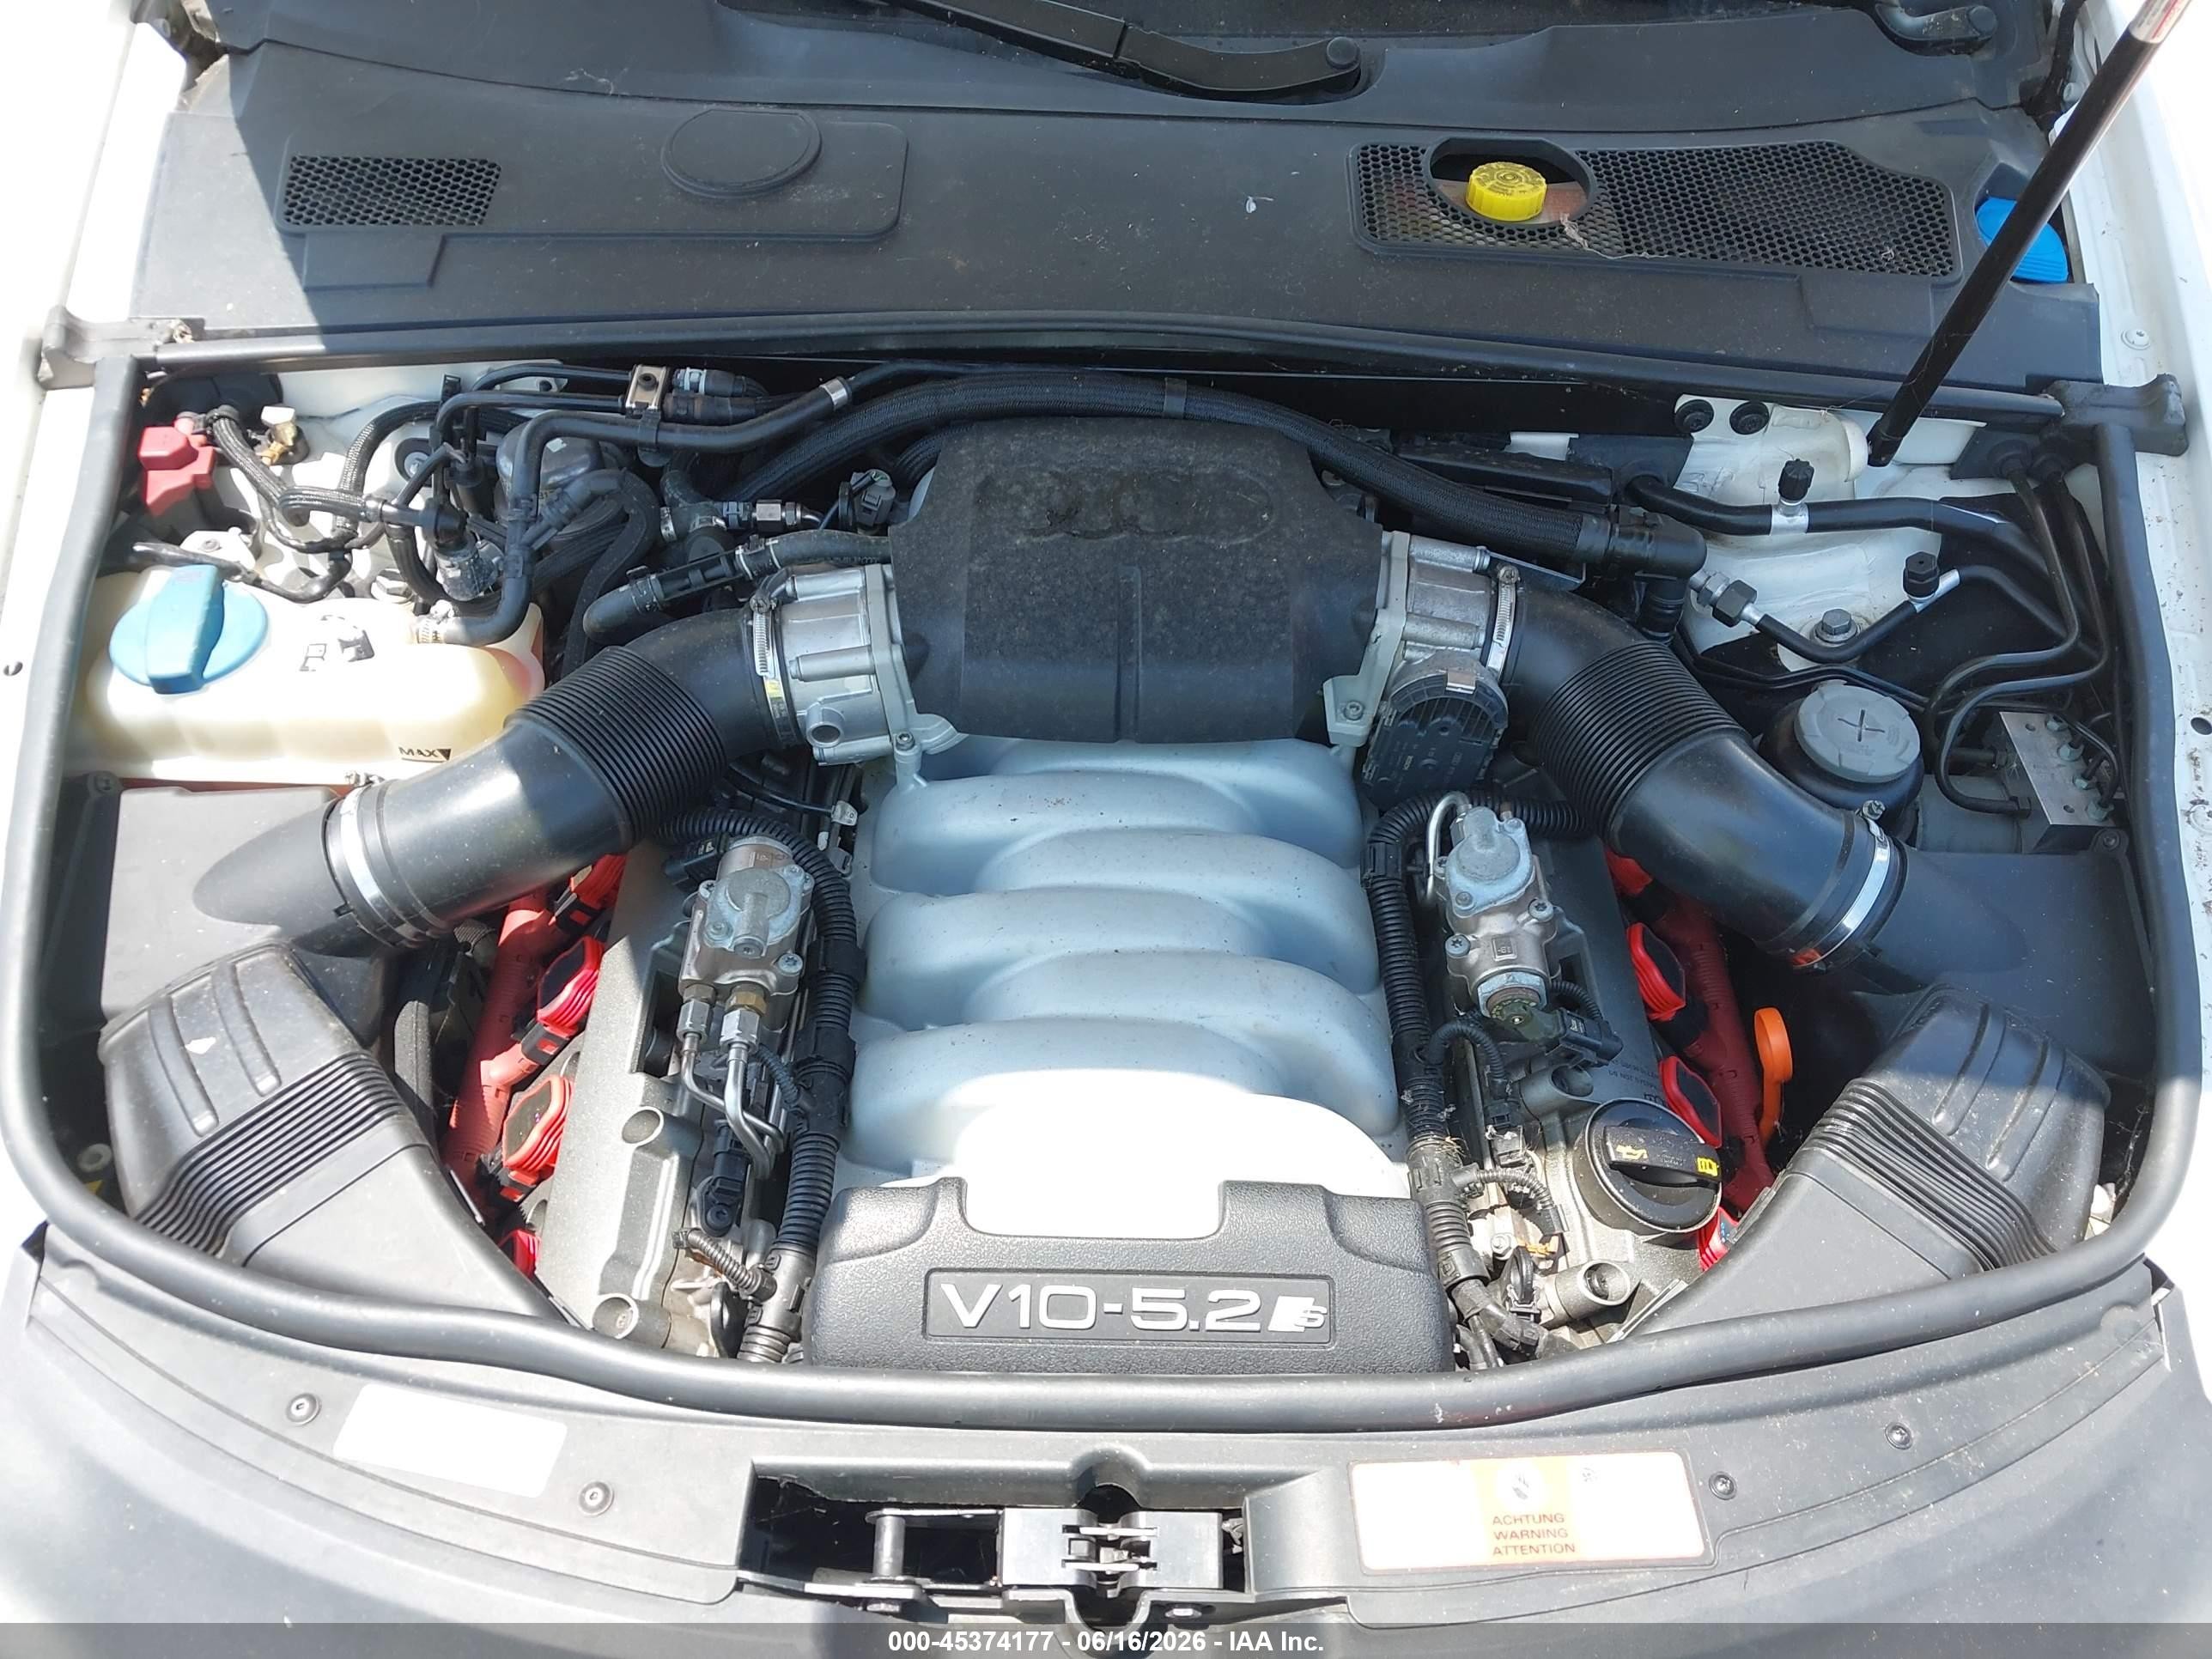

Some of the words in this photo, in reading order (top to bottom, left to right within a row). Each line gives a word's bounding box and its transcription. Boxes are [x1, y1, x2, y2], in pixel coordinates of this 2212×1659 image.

[398, 746, 439, 757] MAX
[940, 1283, 1262, 1332] V10-5.2
[1492, 1512, 1565, 1525] ACHTUNG
[1493, 1528, 1568, 1540] WARNING
[1492, 1542, 1575, 1556] ATTENTION
